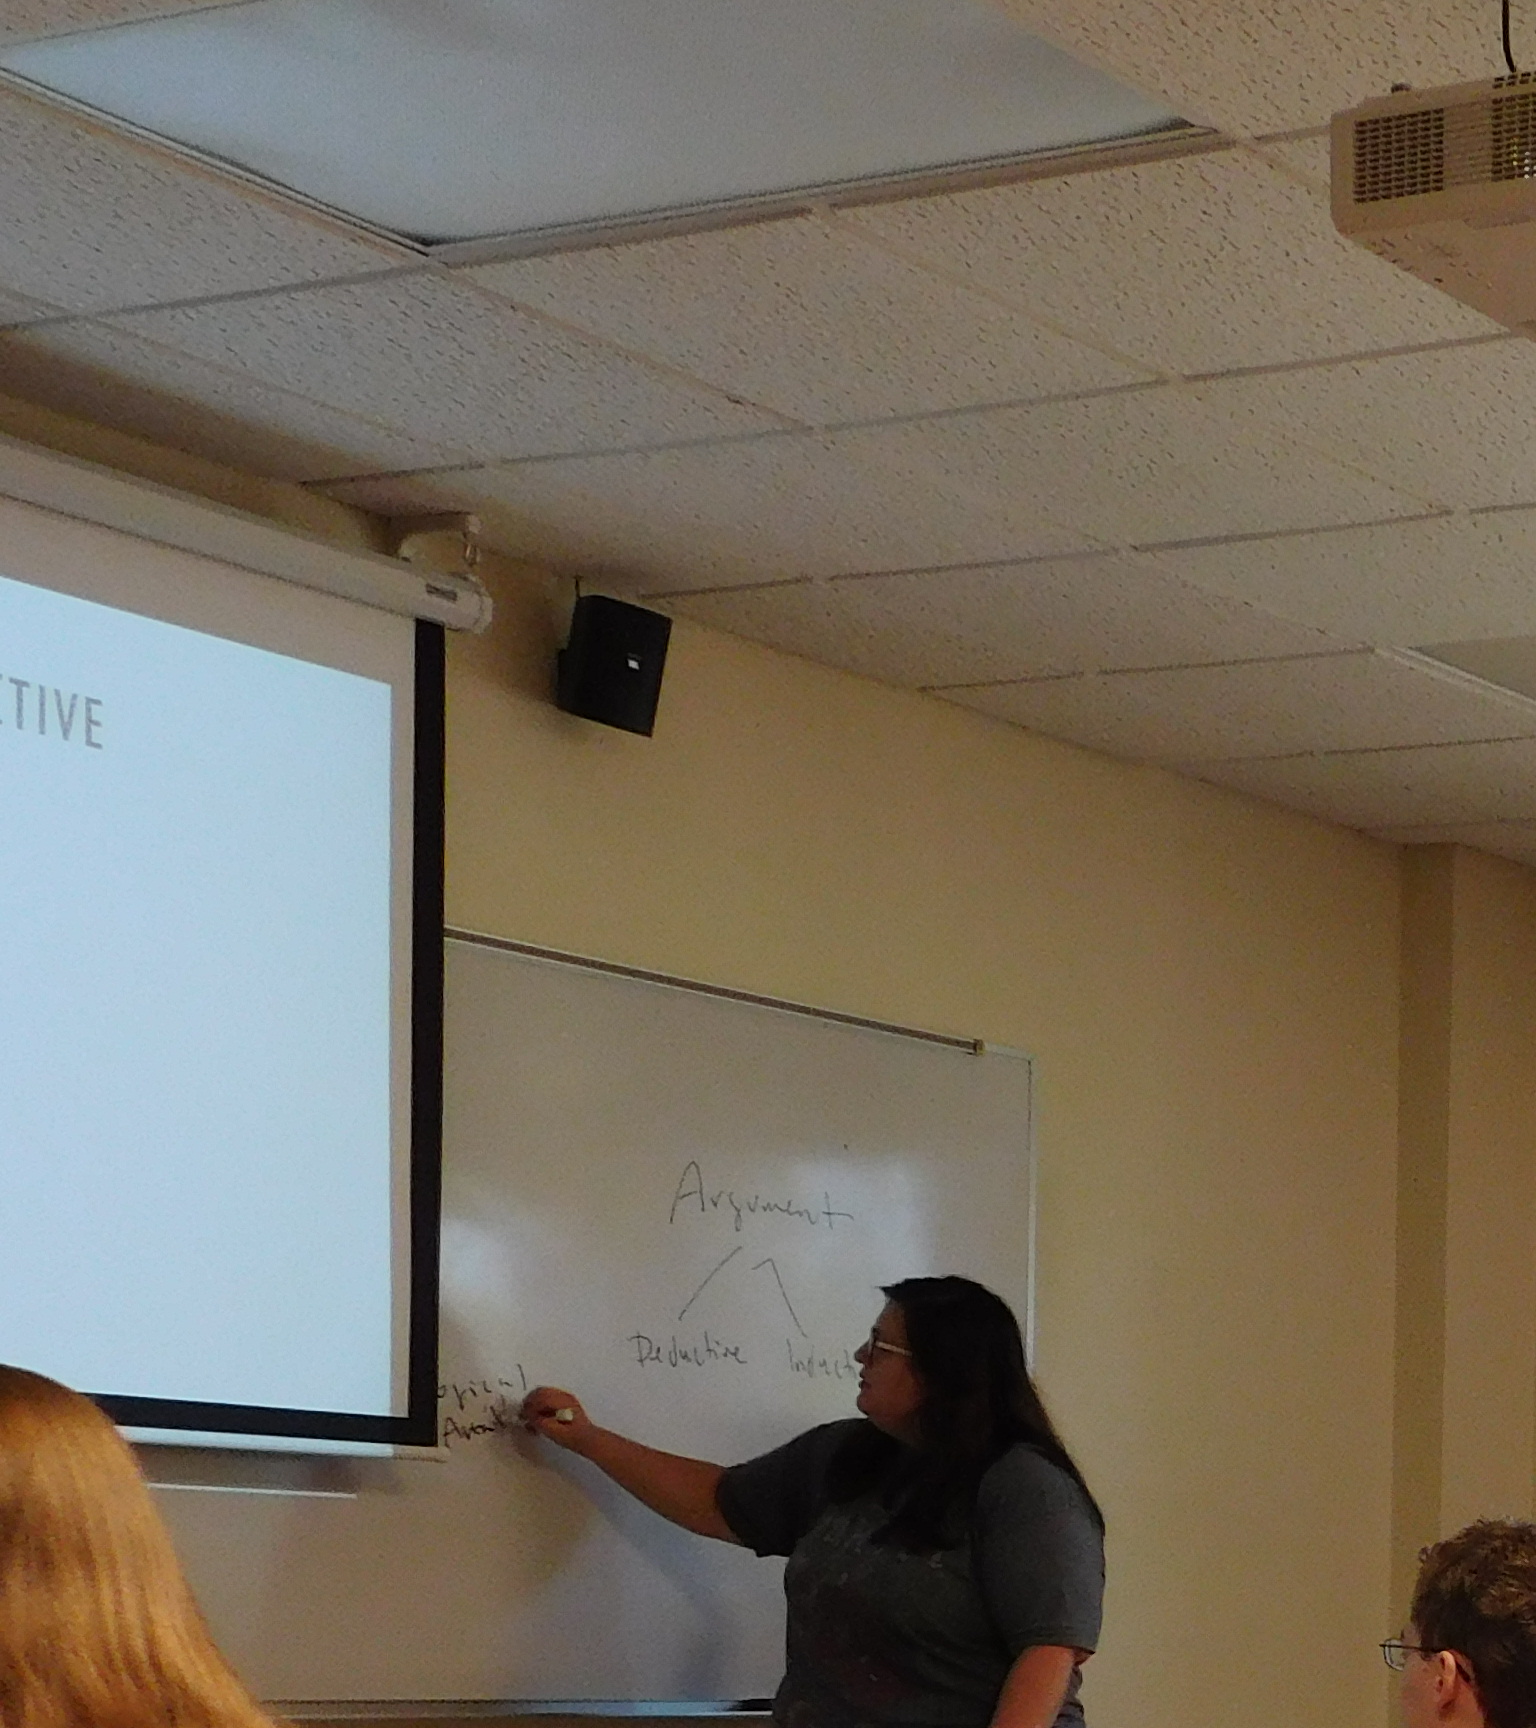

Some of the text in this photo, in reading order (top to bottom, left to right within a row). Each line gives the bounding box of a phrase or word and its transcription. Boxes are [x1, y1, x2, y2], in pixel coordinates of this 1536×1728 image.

[0, 674, 103, 749] TIVE
[669, 1161, 854, 1231] Argument
[627, 1331, 748, 1368] Deductive
